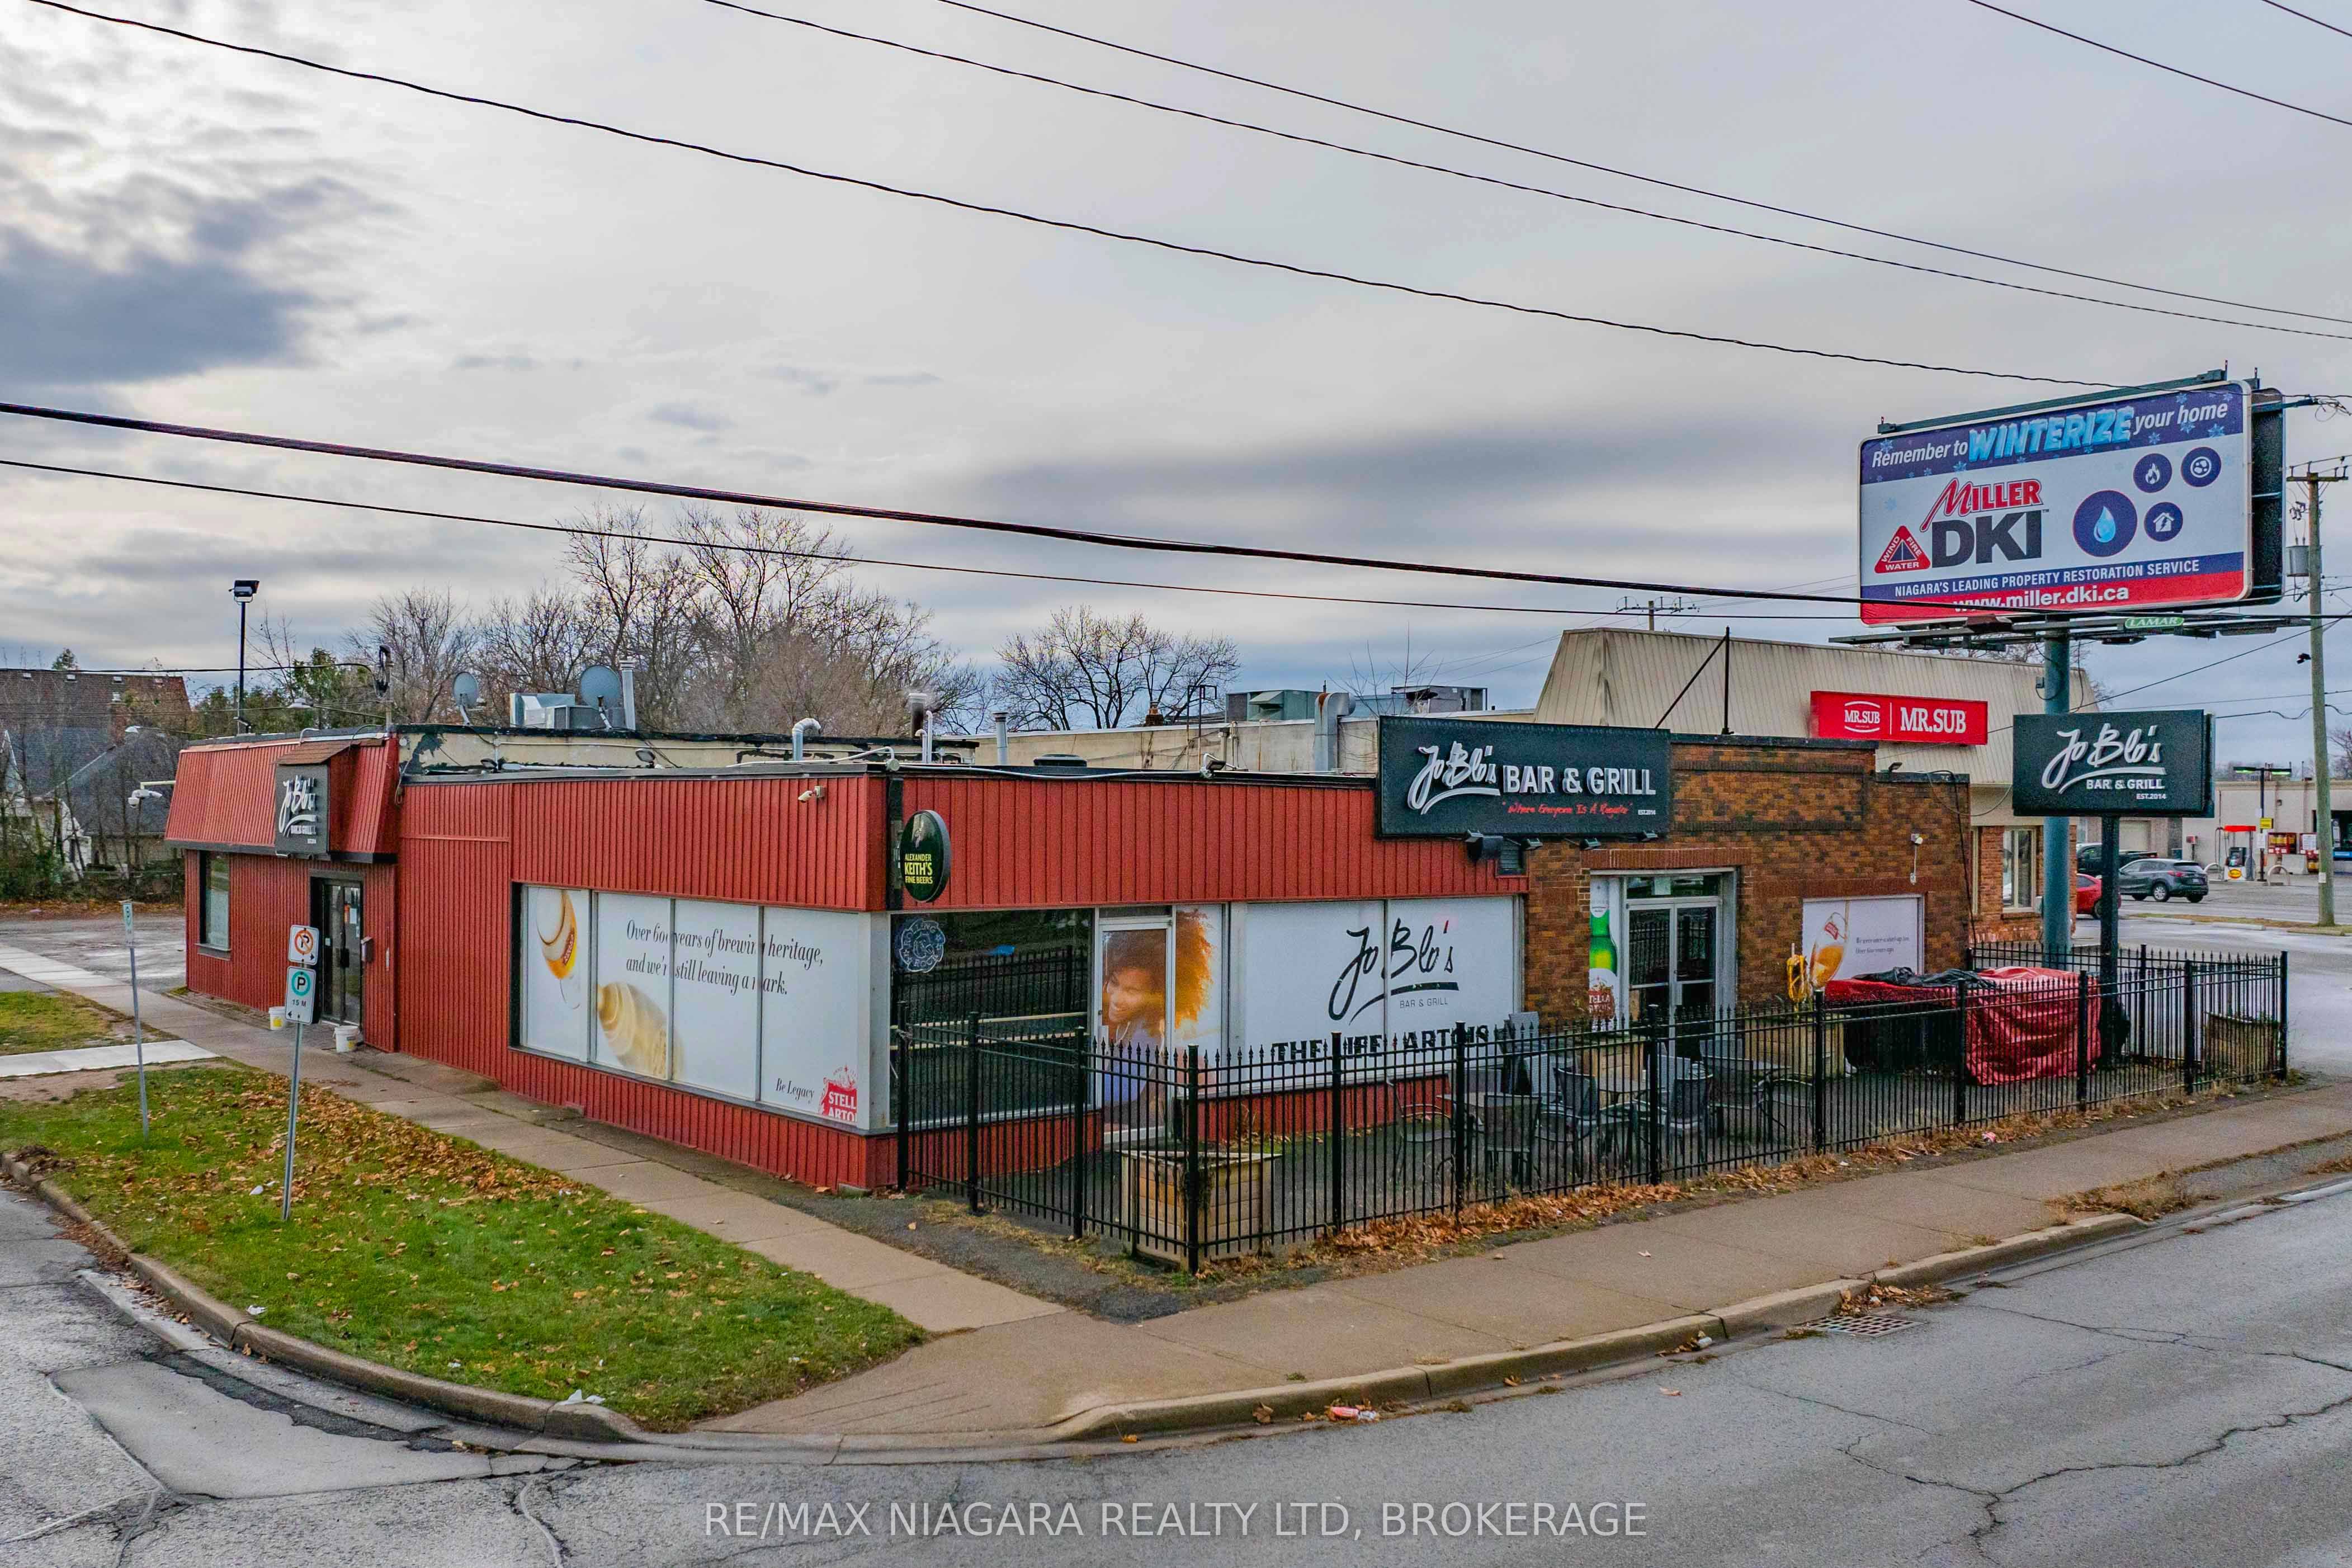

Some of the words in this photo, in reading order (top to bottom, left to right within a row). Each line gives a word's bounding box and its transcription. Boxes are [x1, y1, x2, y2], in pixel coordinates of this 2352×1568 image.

[1872, 443, 1951, 468] Remember
[1953, 440, 1968, 457] to
[1968, 405, 2134, 463] WINTERIZE
[2133, 411, 2175, 436] your
[2177, 403, 2228, 424] home
[1881, 536, 1900, 562] WIND
[1906, 537, 1922, 556] FIRE
[1931, 510, 2042, 569] DKI
[1885, 562, 1919, 570] WATER
[1895, 582, 1949, 597] NIAGARA'S
[1953, 577, 1998, 592] LEADING
[2002, 572, 2060, 588] PROPERTY
[2063, 565, 2143, 583] RESTORATION
[2147, 560, 2199, 575] SERVICE
[2129, 617, 2179, 627] LAMAR
[1844, 710, 1881, 724] MR.SUB
[1900, 706, 1967, 734] MR.SUB
[1503, 765, 1556, 794] BAR
[1562, 767, 1583, 794] &
[1586, 767, 1656, 795] GRILL
[2086, 779, 2112, 790] BAR
[2114, 780, 2126, 790] &
[2127, 779, 2165, 790] GRILL
[904, 862, 933, 876] KEITH'S
[626, 919, 651, 941] Over
[705, 928, 719, 958] of
[768, 934, 823, 971] heritage,
[297, 976, 306, 990] P
[626, 952, 646, 973] and
[647, 955, 669, 976] we'r
[675, 959, 697, 981] still
[697, 960, 739, 996] leaving
[742, 975, 749, 989] a
[1400, 999, 1415, 1009] BAR
[1418, 999, 1424, 1007] &
[1427, 997, 1449, 1007] GRILL
[1272, 1039, 1324, 1062] THE
[1334, 1035, 1383, 1059] IFE
[1404, 1025, 1489, 1053] ARTIS
[776, 1078, 786, 1092] Be
[787, 1080, 815, 1104] Legacy
